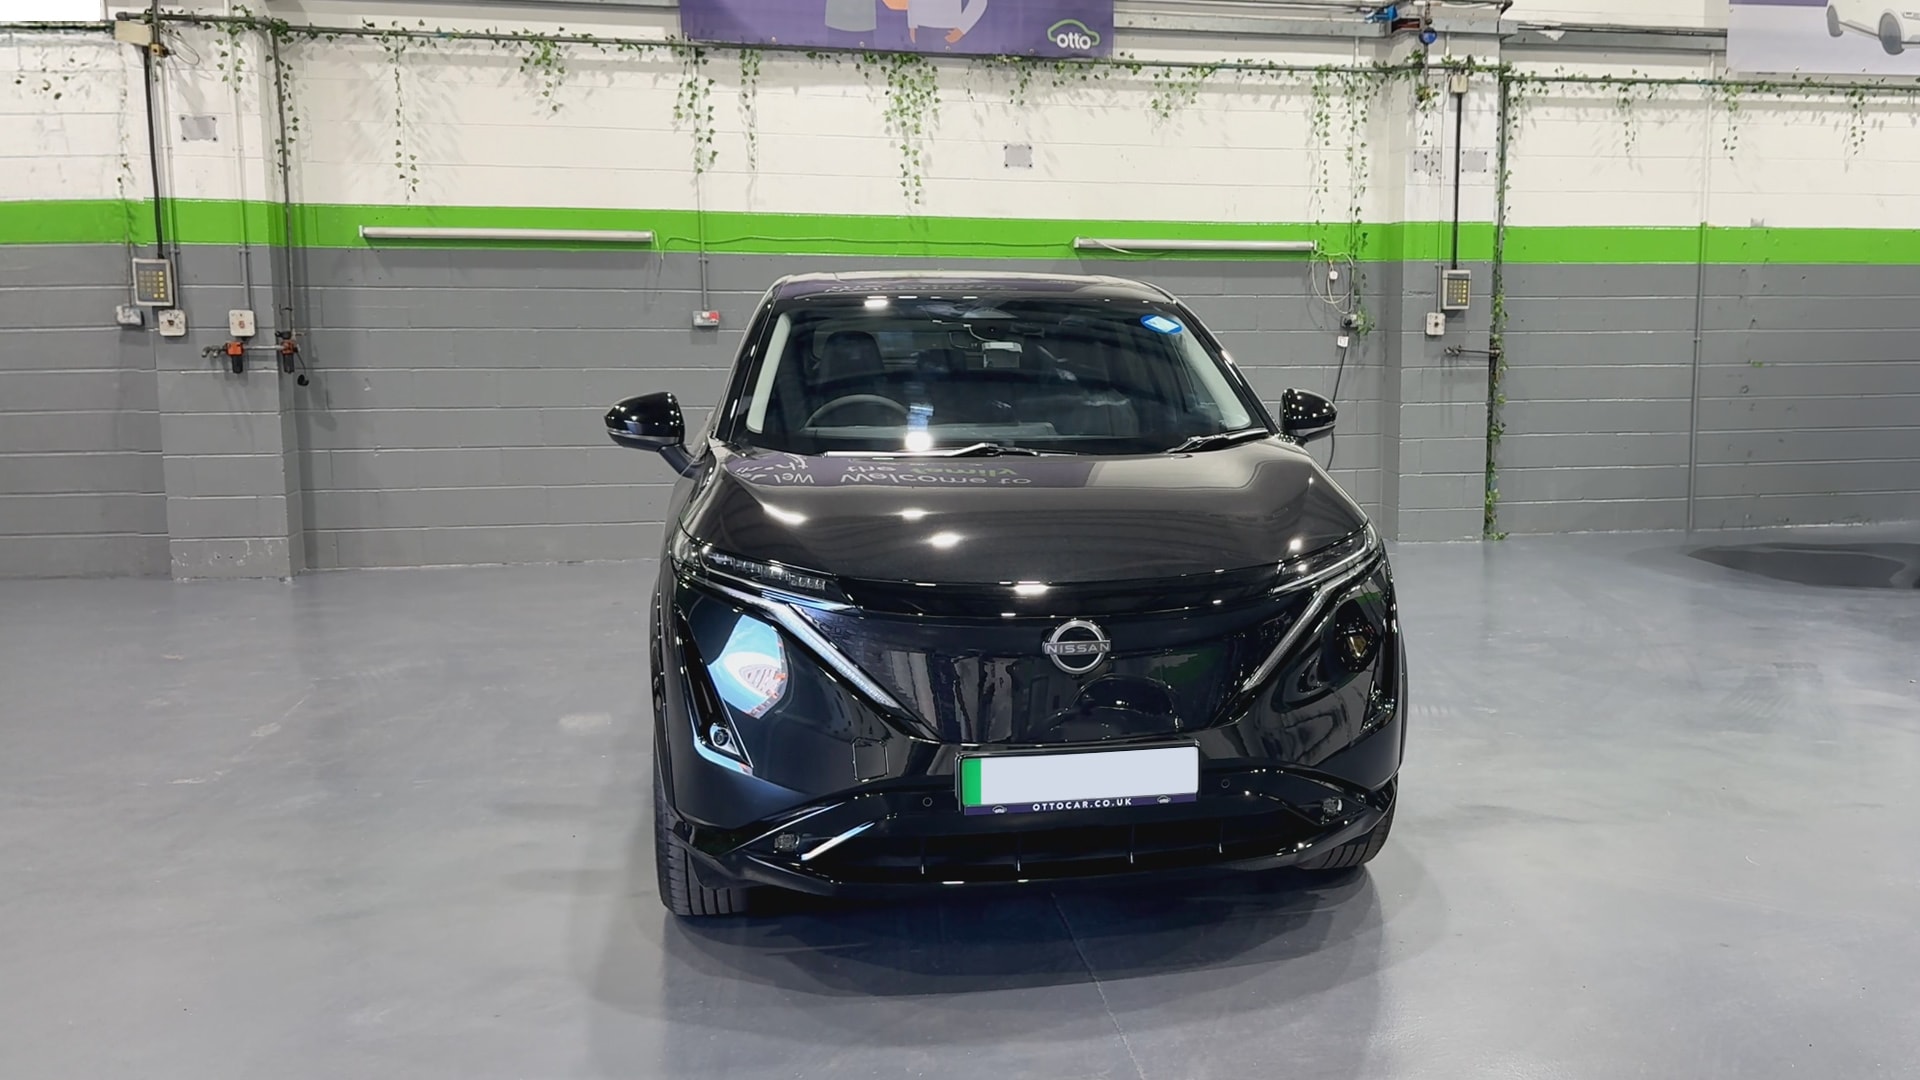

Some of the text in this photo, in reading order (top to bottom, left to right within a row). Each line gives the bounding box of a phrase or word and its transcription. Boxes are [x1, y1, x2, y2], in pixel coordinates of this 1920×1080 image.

[1056, 31, 1091, 50] otto
[1046, 643, 1110, 654] NISSAN
[1032, 798, 1132, 811] OTTOCAR.CO.UK
